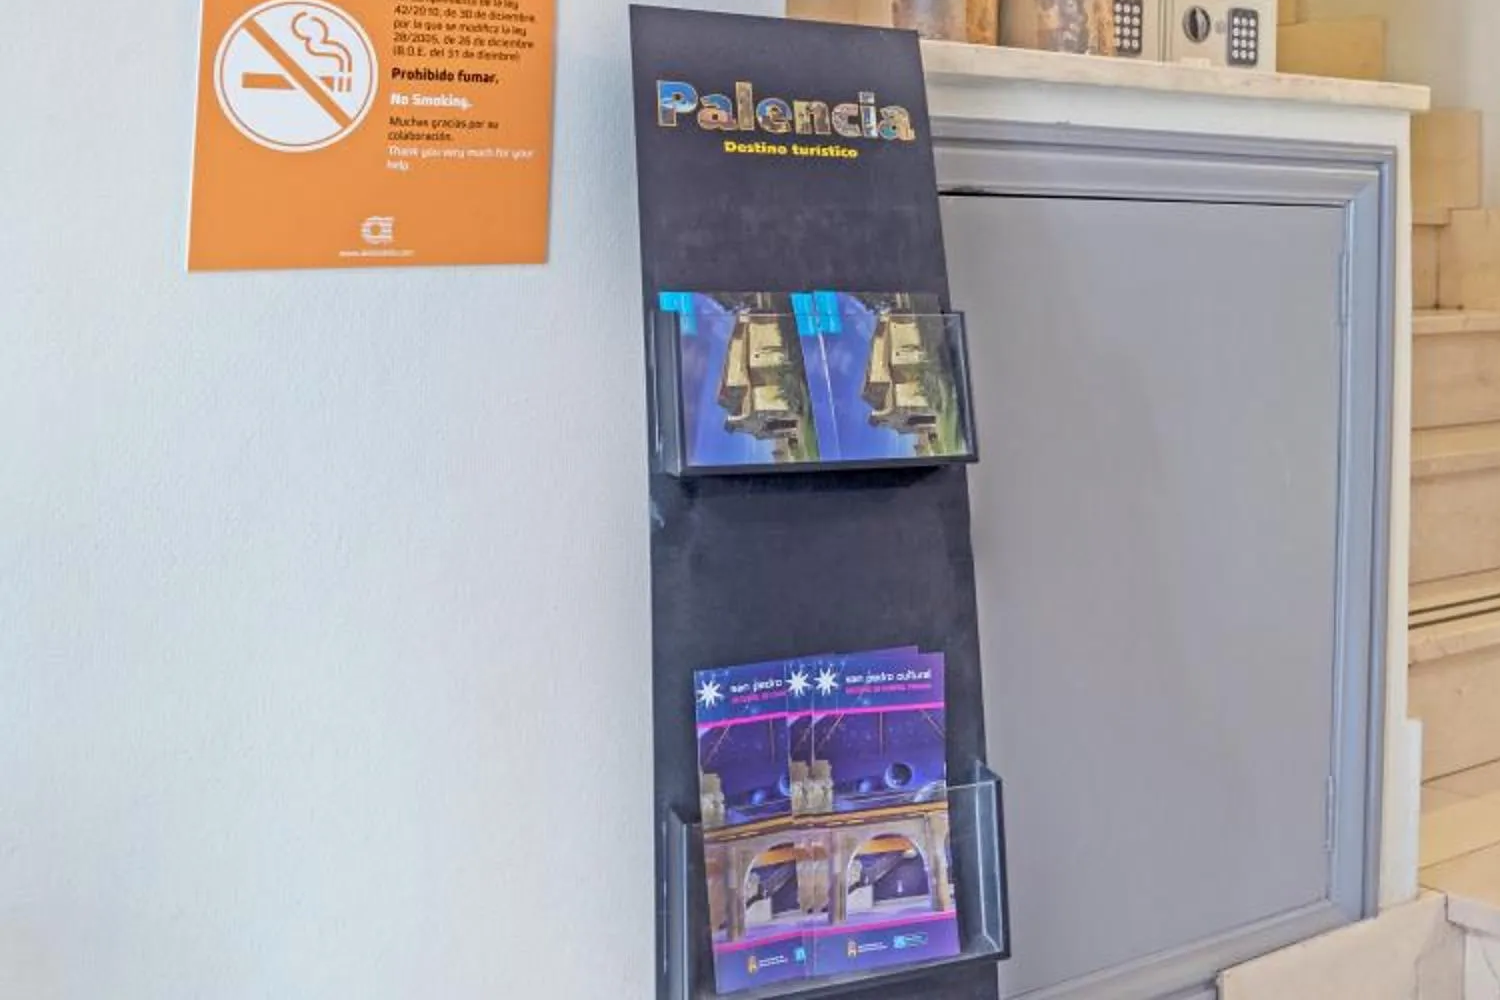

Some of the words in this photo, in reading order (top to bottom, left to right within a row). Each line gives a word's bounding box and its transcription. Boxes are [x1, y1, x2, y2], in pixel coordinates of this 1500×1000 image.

[391, 66, 455, 83] Prohibido
[457, 69, 499, 85] fumar.
[389, 91, 409, 106] No
[656, 78, 916, 141] Palencia
[389, 115, 429, 128] Muchas
[431, 117, 467, 130] gracias
[722, 139, 788, 156] Destino
